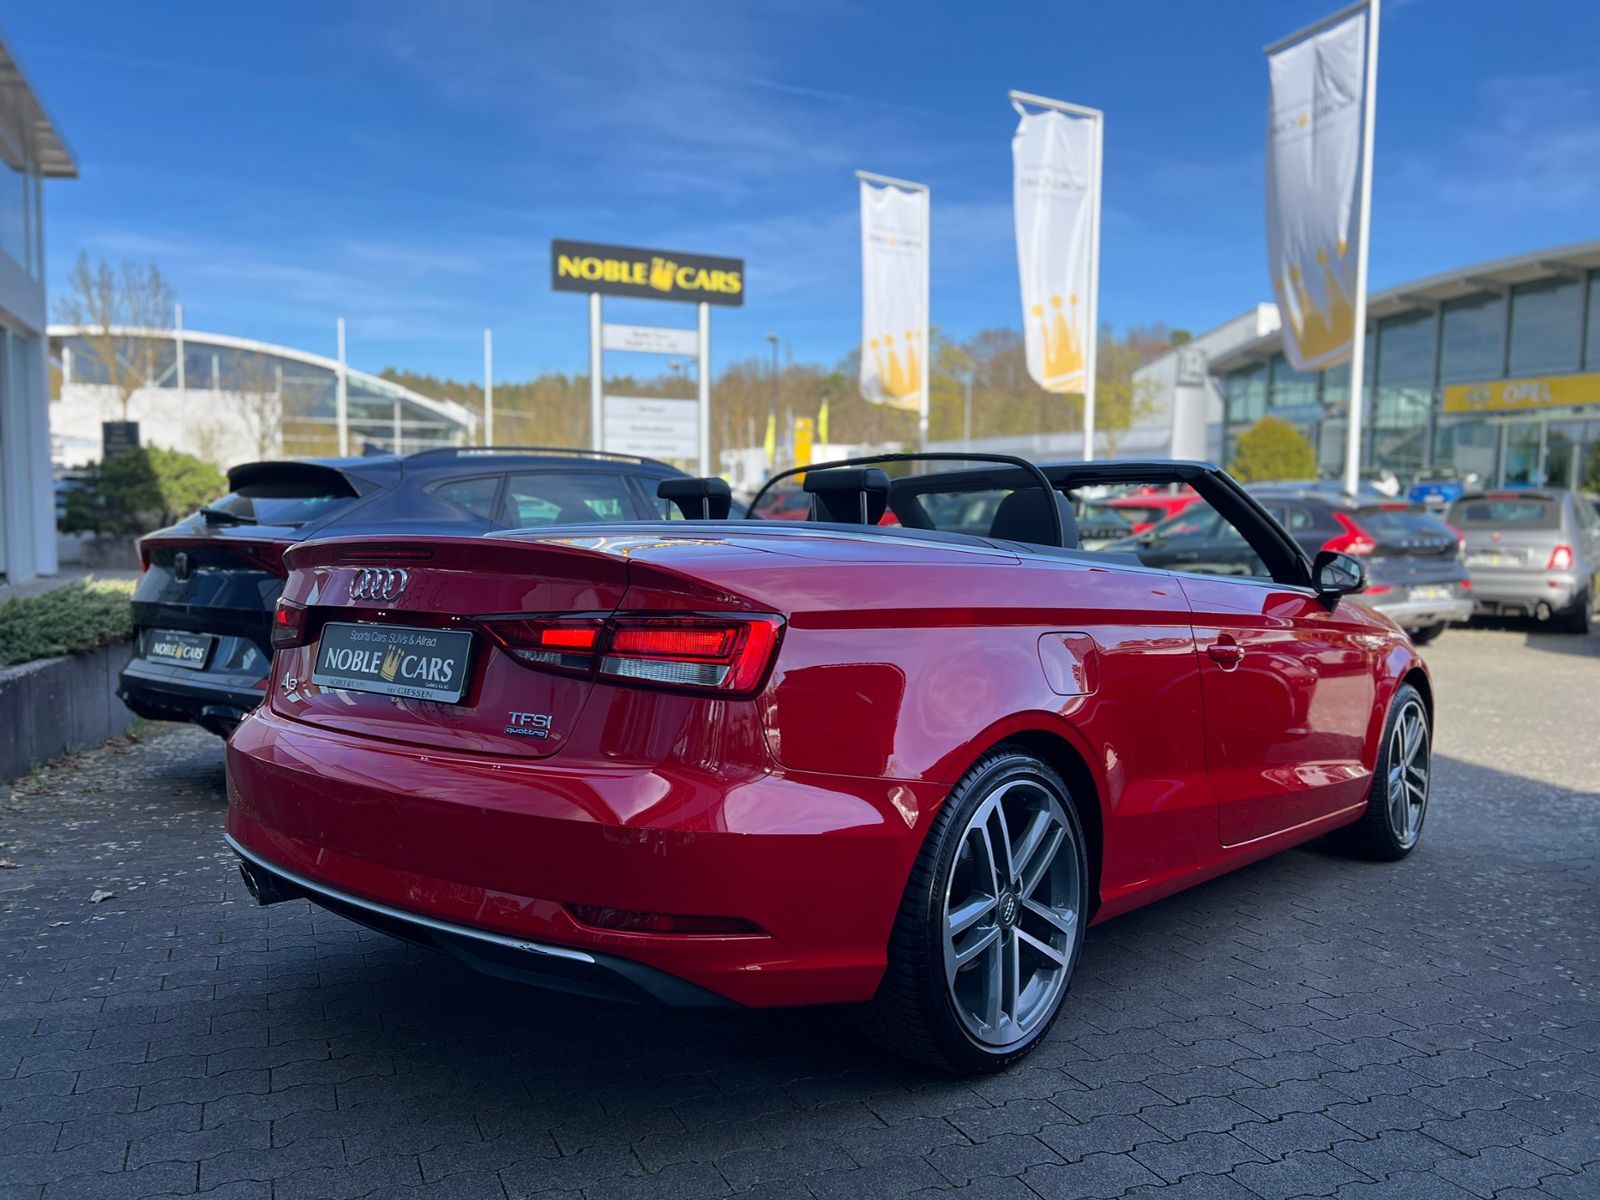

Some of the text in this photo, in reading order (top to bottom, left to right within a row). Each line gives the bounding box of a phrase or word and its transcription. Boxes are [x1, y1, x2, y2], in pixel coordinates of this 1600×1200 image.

[558, 254, 742, 294] NOBLE CARS
[350, 630, 371, 641] Sports
[408, 634, 414, 645] &
[415, 635, 437, 647] Allrad
[152, 642, 204, 660] NOBLE CARS
[325, 647, 455, 683] NOBLE CARS
[397, 686, 434, 699] GIESSEN
[508, 711, 553, 730] TFSI
[505, 727, 546, 738] quattro
